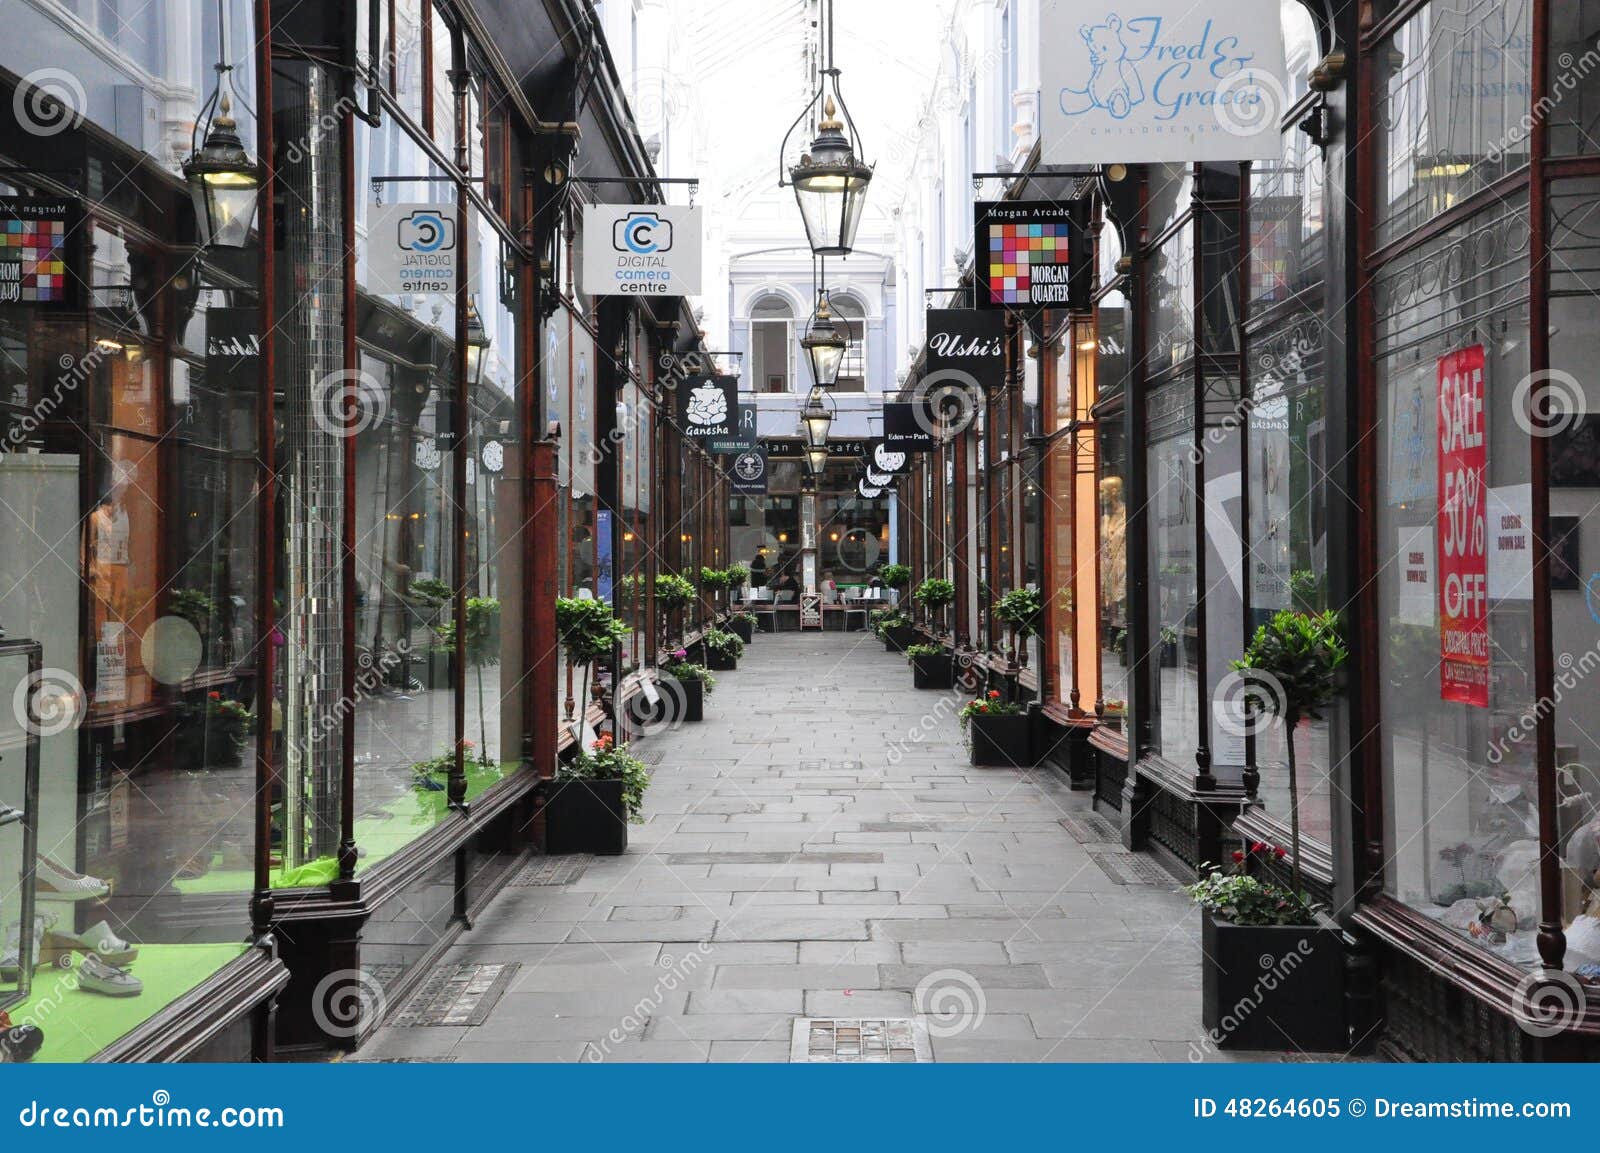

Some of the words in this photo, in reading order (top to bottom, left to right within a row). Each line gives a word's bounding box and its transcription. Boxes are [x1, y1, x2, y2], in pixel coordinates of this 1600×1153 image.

[1124, 16, 1212, 62] Fred
[1208, 36, 1254, 79] &
[1090, 124, 1235, 136] CHILDRENSW
[988, 209, 1028, 218] Morgan
[1033, 208, 1070, 216] Arcade
[617, 255, 668, 268] DIGITAL
[615, 270, 671, 281] camera
[1031, 265, 1069, 283] MORGAN
[620, 281, 667, 293] centre
[1031, 284, 1069, 304] QUARTER
[929, 332, 1000, 357] Ushi's
[1440, 368, 1483, 455] SALE
[686, 425, 729, 436] Ganesha
[828, 441, 860, 453] café
[1443, 466, 1485, 557] 50%
[1498, 536, 1513, 551] DOWN
[1514, 536, 1525, 550] SALE
[1444, 572, 1485, 619] OFF
